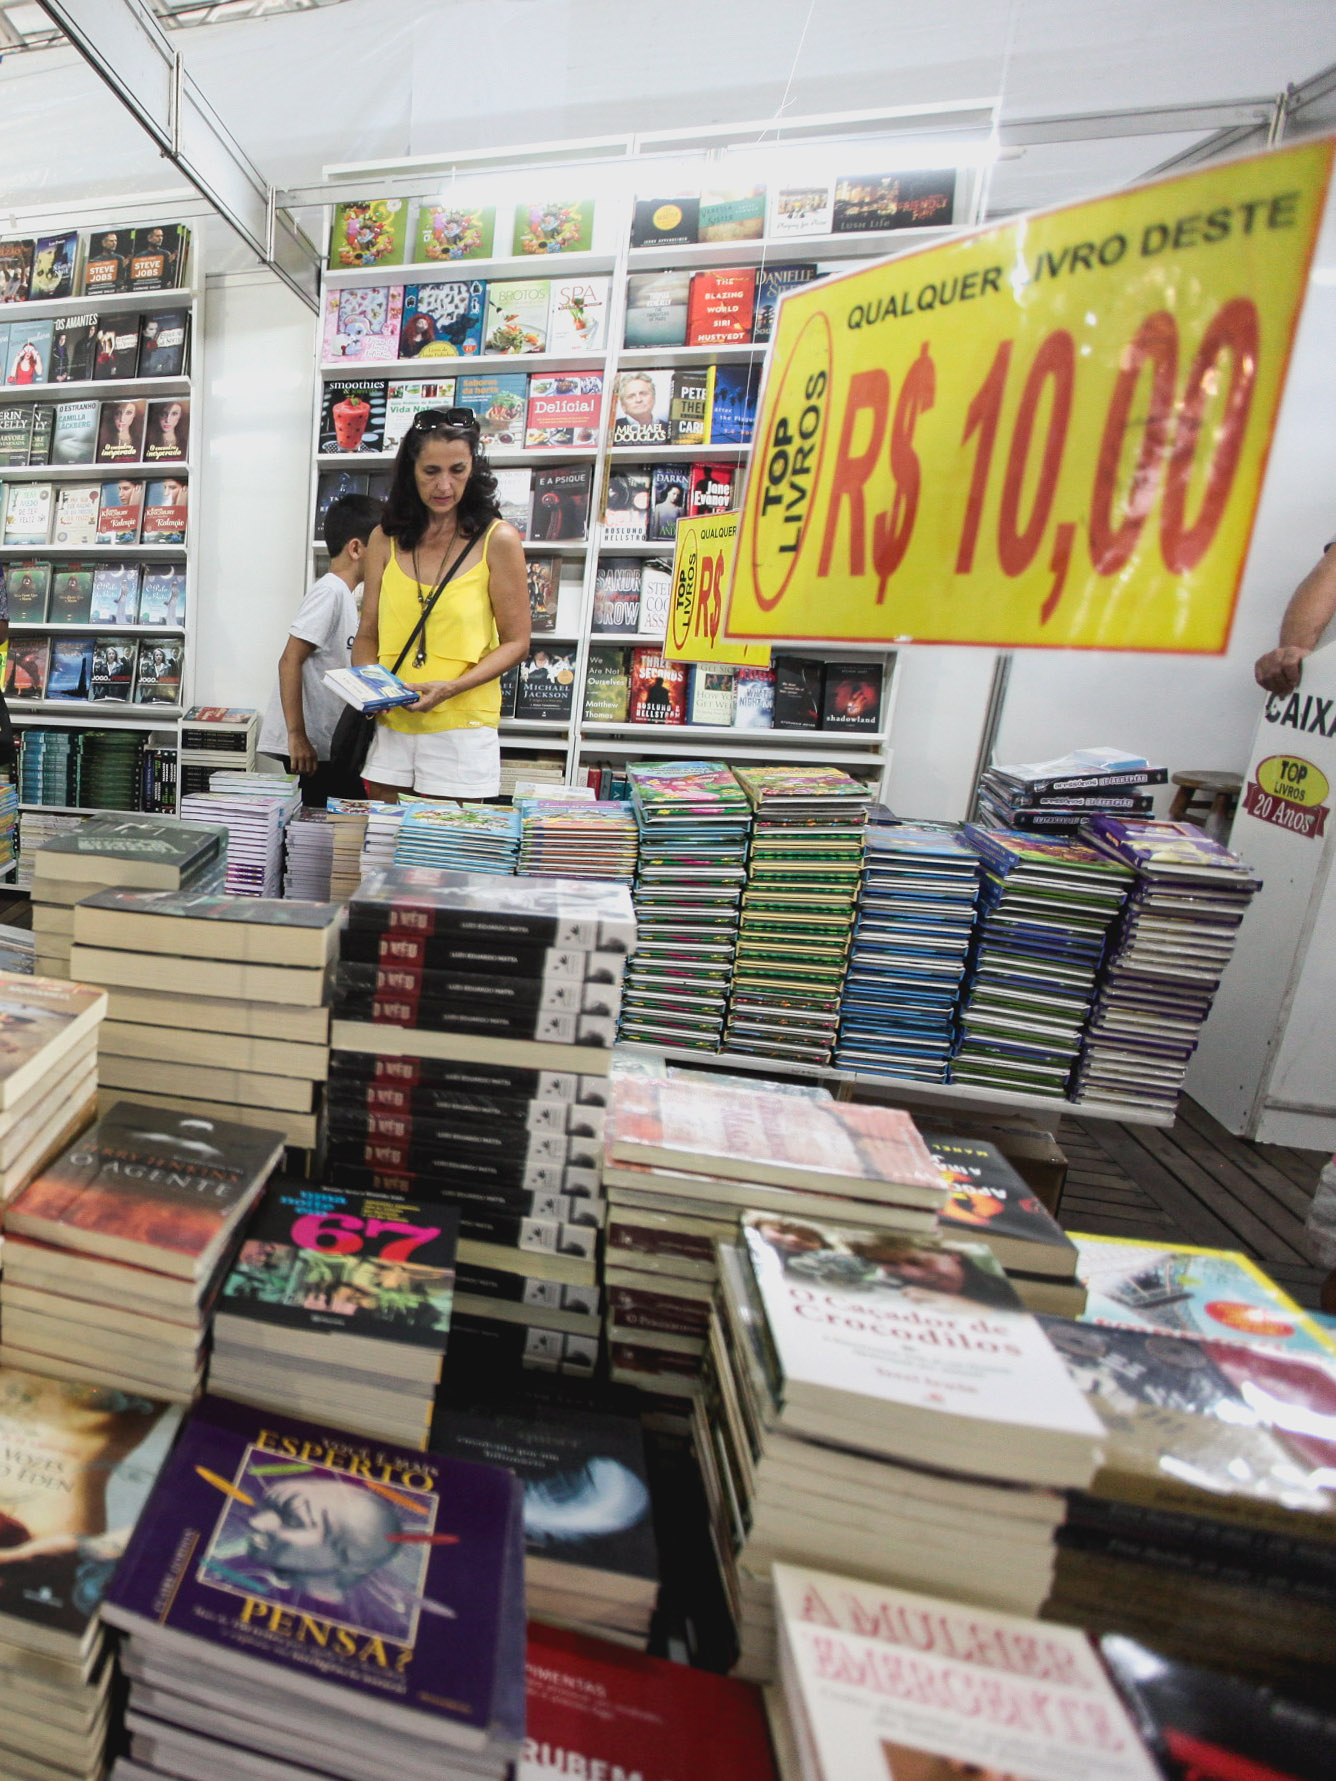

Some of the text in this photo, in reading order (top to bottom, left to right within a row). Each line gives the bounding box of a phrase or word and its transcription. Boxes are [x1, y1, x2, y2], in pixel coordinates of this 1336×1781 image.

[134, 260, 161, 270] STEVE
[847, 192, 1302, 330] QUALQUER IVRO DESTE
[89, 266, 115, 275] STEVE
[135, 268, 159, 278] JOBS
[90, 273, 113, 282] JOBS
[716, 278, 734, 286] THE
[755, 269, 814, 286] DANIELLE
[498, 289, 545, 301] BROTOS
[559, 285, 597, 307] SPA
[705, 292, 744, 300] BLAZING
[55, 313, 99, 331] OS AMANTES
[714, 319, 731, 327] SIRI
[698, 332, 744, 341] HUSTVEDT
[329, 381, 384, 390] smoothies
[681, 386, 707, 399] PETE
[64, 402, 96, 412] ESTRANHO
[390, 405, 412, 413] Vida
[535, 400, 594, 414] Delícia!
[59, 414, 86, 422] CAMILLA
[616, 424, 664, 434] MICHAEL
[614, 432, 666, 442] DOUGLAS
[101, 449, 136, 459] inesperado
[146, 450, 181, 460] inesperado
[762, 417, 795, 517] TOP
[779, 369, 828, 555] LIVROS
[817, 297, 1259, 627] R$ 10,00
[547, 477, 554, 485] A
[554, 475, 586, 484] PSIQUE
[656, 474, 689, 483] DARKN
[597, 569, 641, 591] SANDR
[677, 569, 687, 610] TOP
[682, 553, 697, 628] LIVROS
[694, 549, 725, 649] R$
[596, 602, 639, 625] BROW
[590, 656, 603, 664] We
[605, 667, 620, 675] Not
[639, 668, 684, 682] SECONDS
[523, 683, 570, 691] MICHAEL
[587, 677, 625, 686] Ourselves
[523, 690, 569, 699] JACKSON
[585, 700, 618, 709] Matthew
[637, 703, 672, 712] ROSLUND
[585, 711, 613, 719] Thomas
[826, 714, 876, 724] shadowland
[1265, 692, 1336, 738] CAIX
[1280, 760, 1307, 785] TOP
[1274, 781, 1306, 802] LIVROS
[1253, 793, 1314, 834] 20 Anos
[70, 1153, 234, 1197] O AGENTE
[290, 1212, 442, 1263] 67
[789, 1287, 1008, 1335] O Caçador de
[794, 1304, 1022, 1356] Crocodilos
[6, 1448, 64, 1471] VOZES
[255, 1429, 435, 1491] ESPERTO
[241, 1597, 415, 1674] PENSA?
[801, 1585, 1094, 1690] A MULHER
[804, 1631, 1125, 1753] EMERGENTE
[522, 1737, 644, 1781] RUBEM
